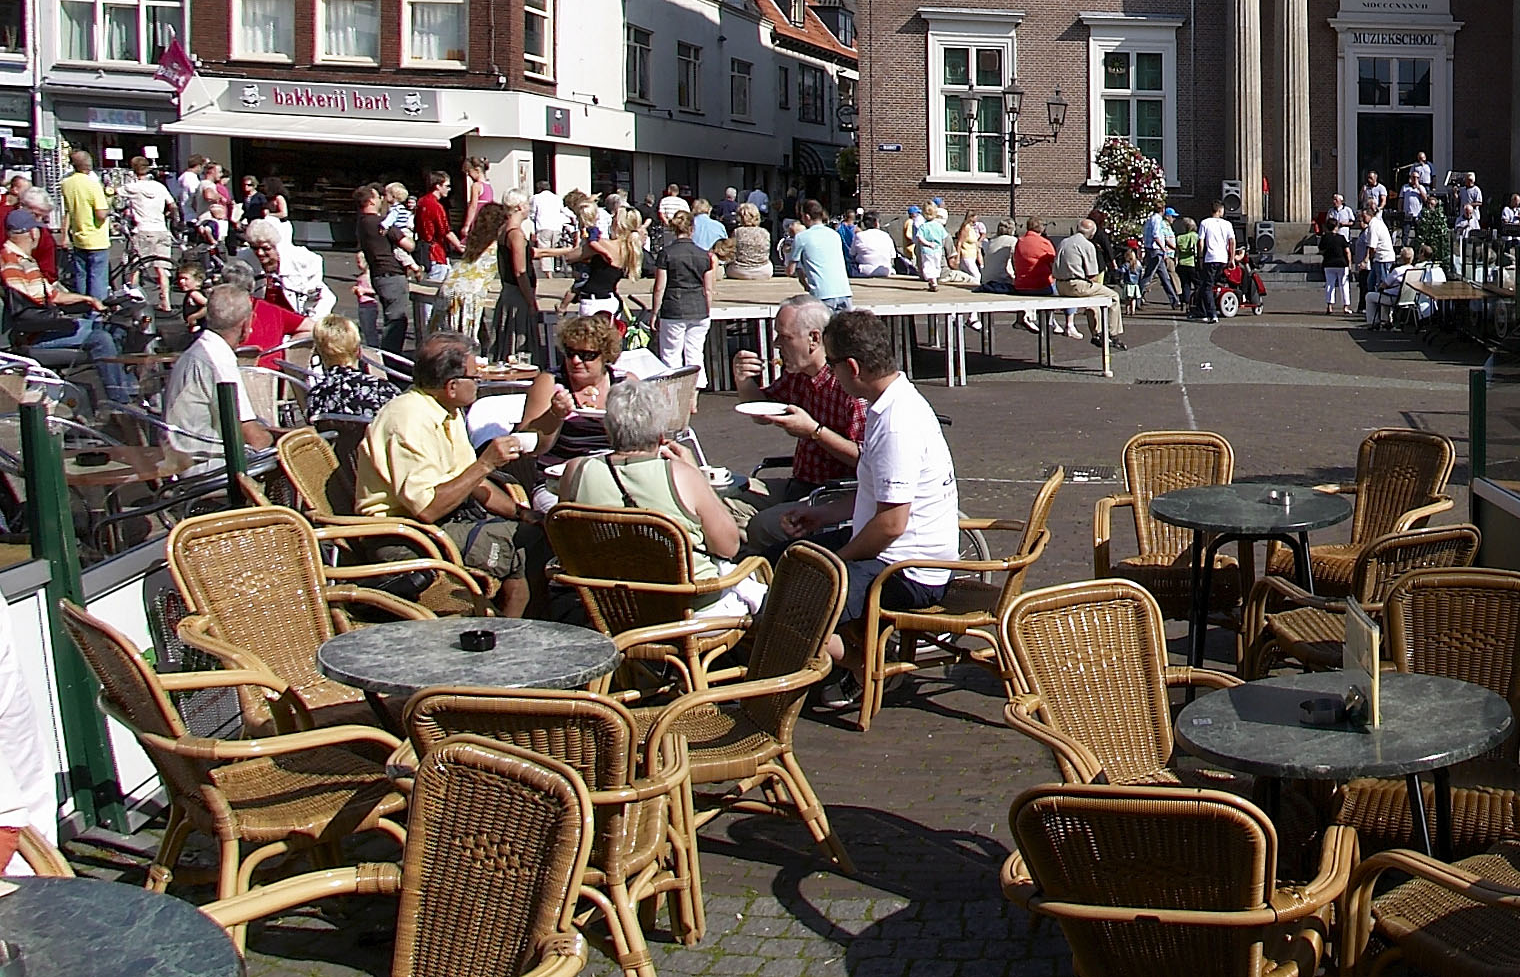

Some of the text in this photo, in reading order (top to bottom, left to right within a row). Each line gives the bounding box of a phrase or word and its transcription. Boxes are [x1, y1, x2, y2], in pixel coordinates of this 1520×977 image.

[1353, 32, 1438, 46] MUZIEKSCHOOL
[273, 86, 392, 112] bakkerij bart
